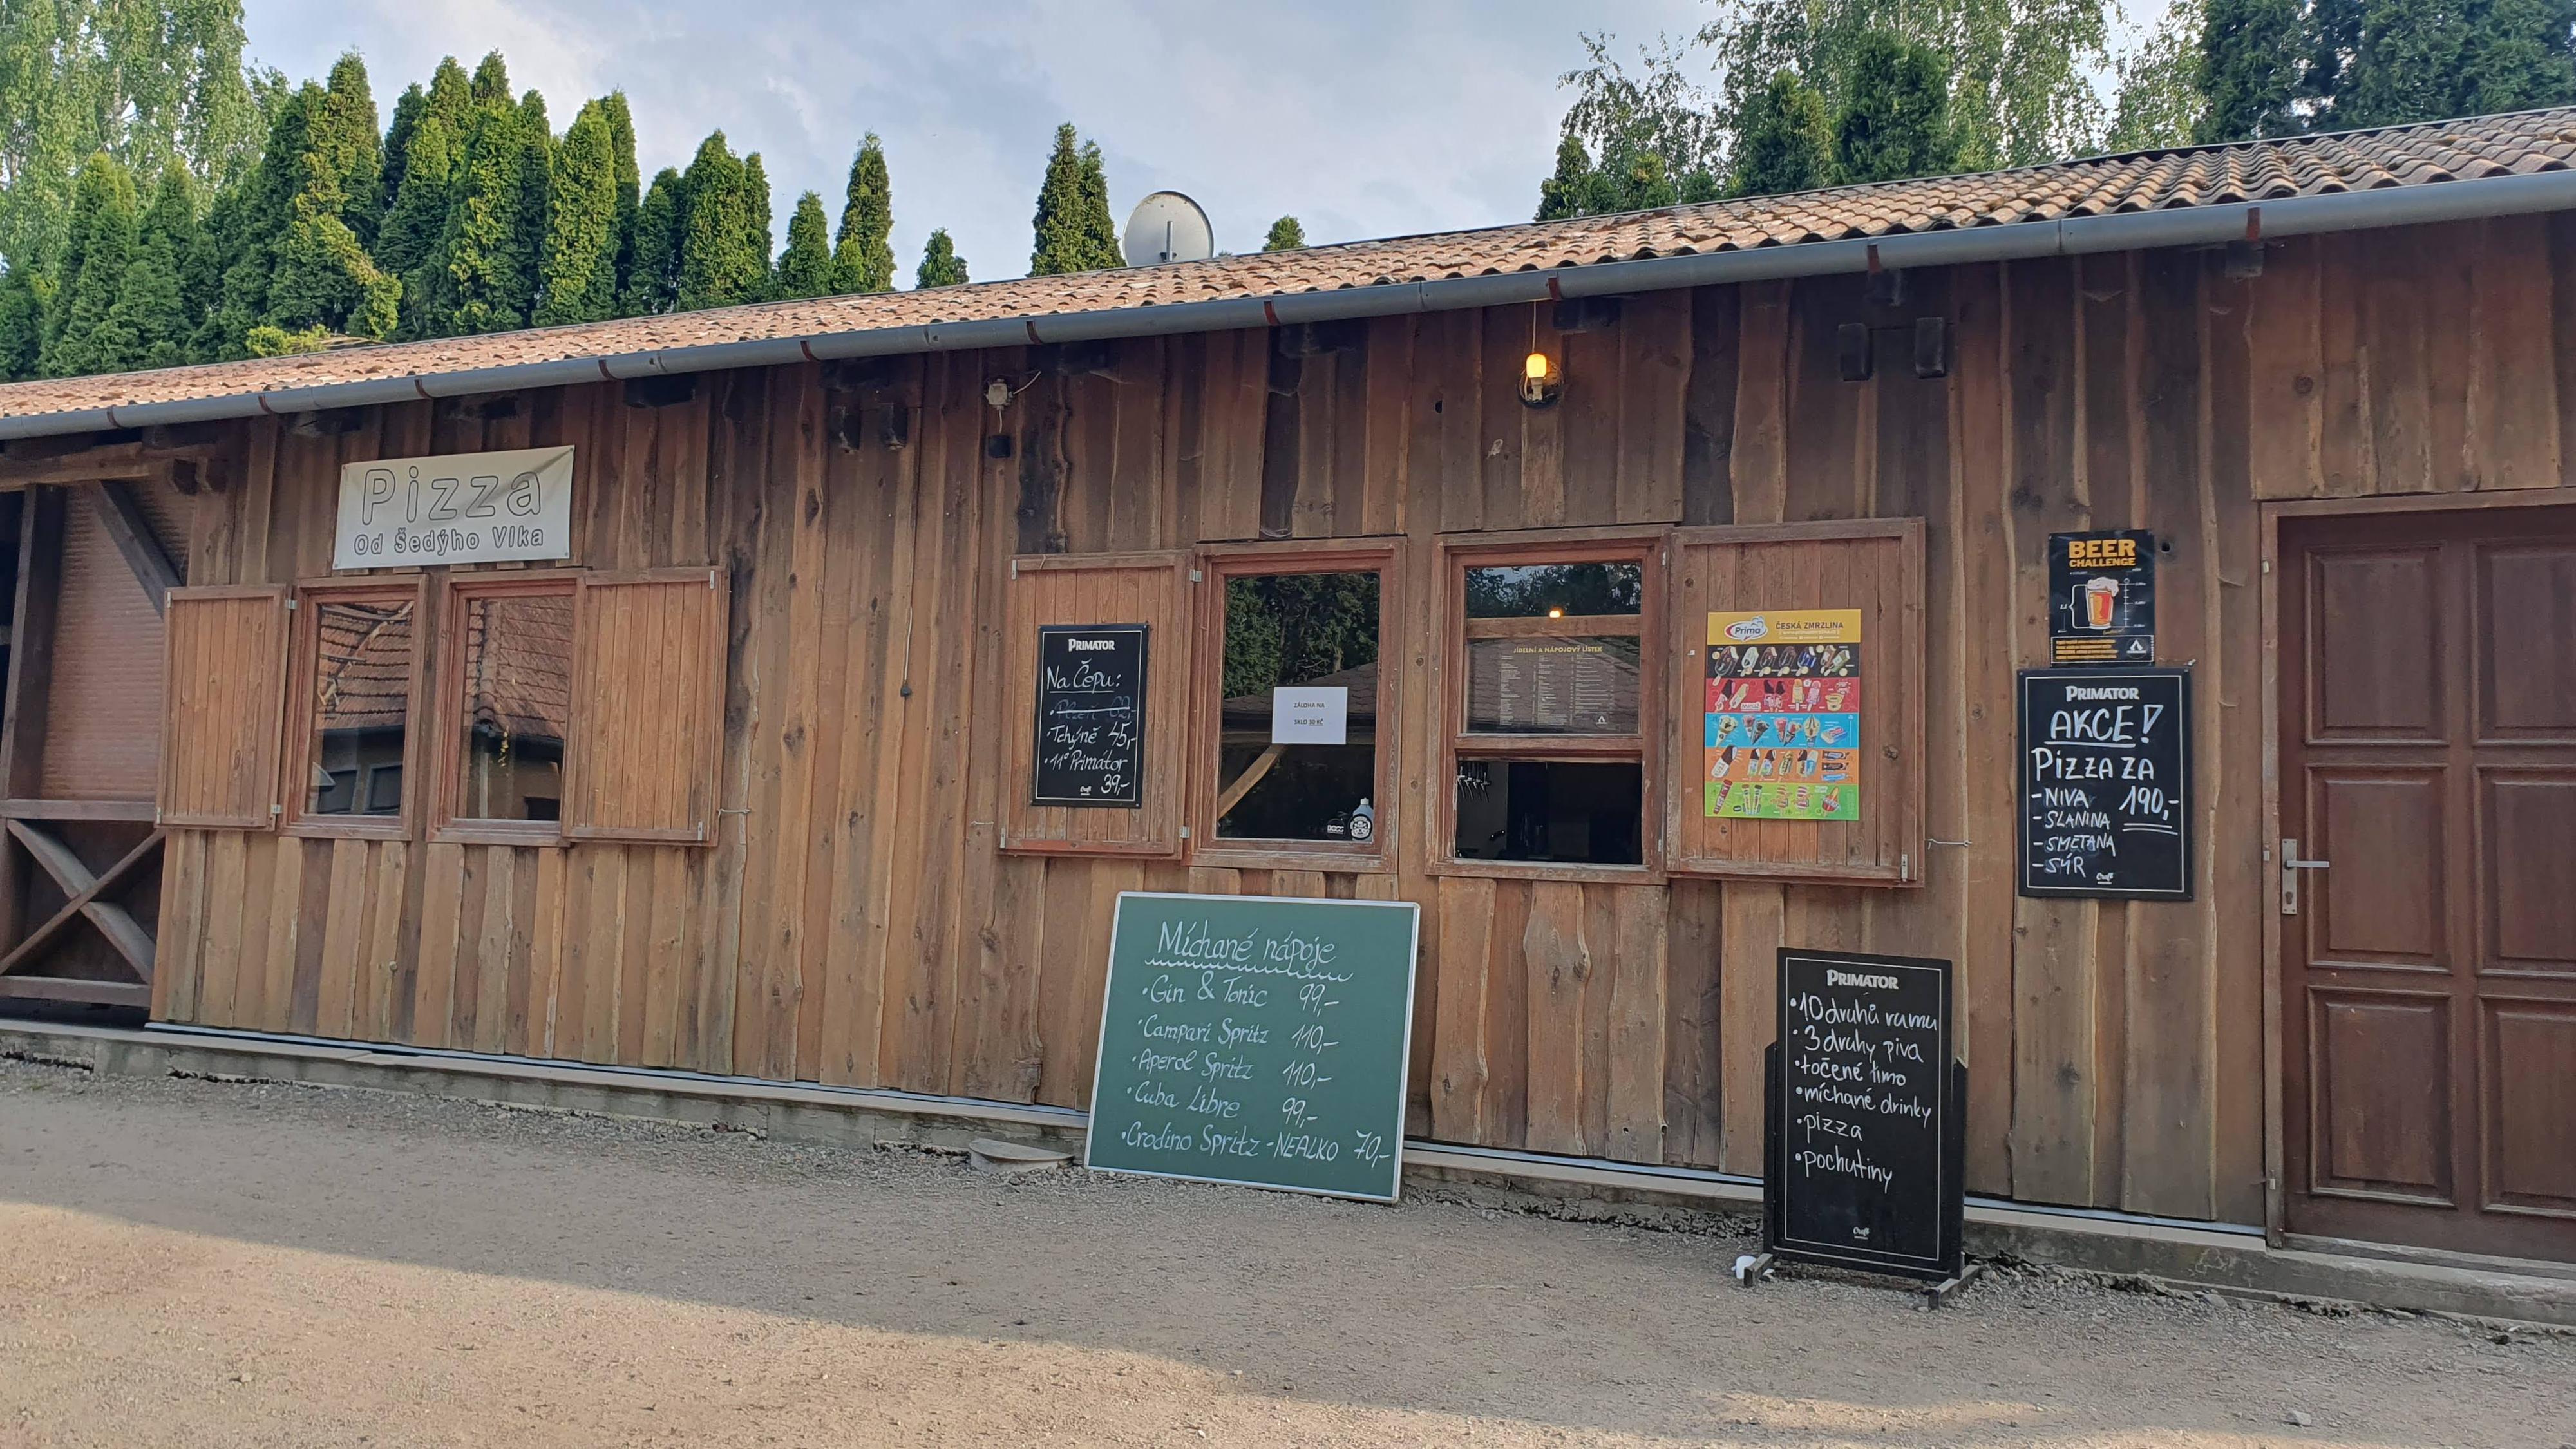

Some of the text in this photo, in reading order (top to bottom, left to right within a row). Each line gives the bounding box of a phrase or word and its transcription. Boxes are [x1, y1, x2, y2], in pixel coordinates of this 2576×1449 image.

[362, 465, 541, 526] Pizza
[354, 525, 544, 556] Od Šedýho Vlka
[2069, 539, 2136, 559] BEER
[2069, 558, 2136, 568] CHALLENGE
[1734, 625, 1761, 636] Prima
[1776, 621, 1801, 630] ČESKÁ
[1068, 639, 1115, 652] PRIMATOR
[1046, 658, 1122, 693] Na Čepu:
[2065, 685, 2140, 702] PRIMATOR
[1050, 724, 1102, 750] Tchýně
[2050, 704, 2164, 744] AKCE!
[1070, 749, 1129, 772] Primátor
[2121, 757, 2155, 781] ZA
[2045, 787, 2090, 809] NIVA
[2045, 810, 2111, 831] SLANINA
[2046, 832, 2116, 857] SMETANA
[2045, 852, 2087, 878] SÝR
[1158, 918, 1340, 974] Míchané nápoje
[1150, 974, 1186, 1004] Gin
[1197, 969, 1216, 1001] &
[1224, 975, 1269, 1008] Tonic
[1826, 969, 1900, 990] PRIMATOR
[1799, 992, 1824, 1023] 10
[1825, 997, 1880, 1026] druhů
[1142, 1013, 1211, 1044] Campari
[1218, 1016, 1269, 1050] Spritz
[1804, 1025, 1925, 1063] 3 druhy piva
[1138, 1048, 1195, 1075] Aperol
[1200, 1052, 1255, 1083] Spritz
[1135, 1080, 1180, 1109] Cuba
[1186, 1085, 1241, 1119] Libre
[1804, 1082, 1932, 1129] míchané drinky
[1125, 1121, 1193, 1151] Crodino
[1199, 1124, 1261, 1158] Spritz
[1803, 1112, 1864, 1144] pizza
[1803, 1145, 1893, 1195] pochutiny
